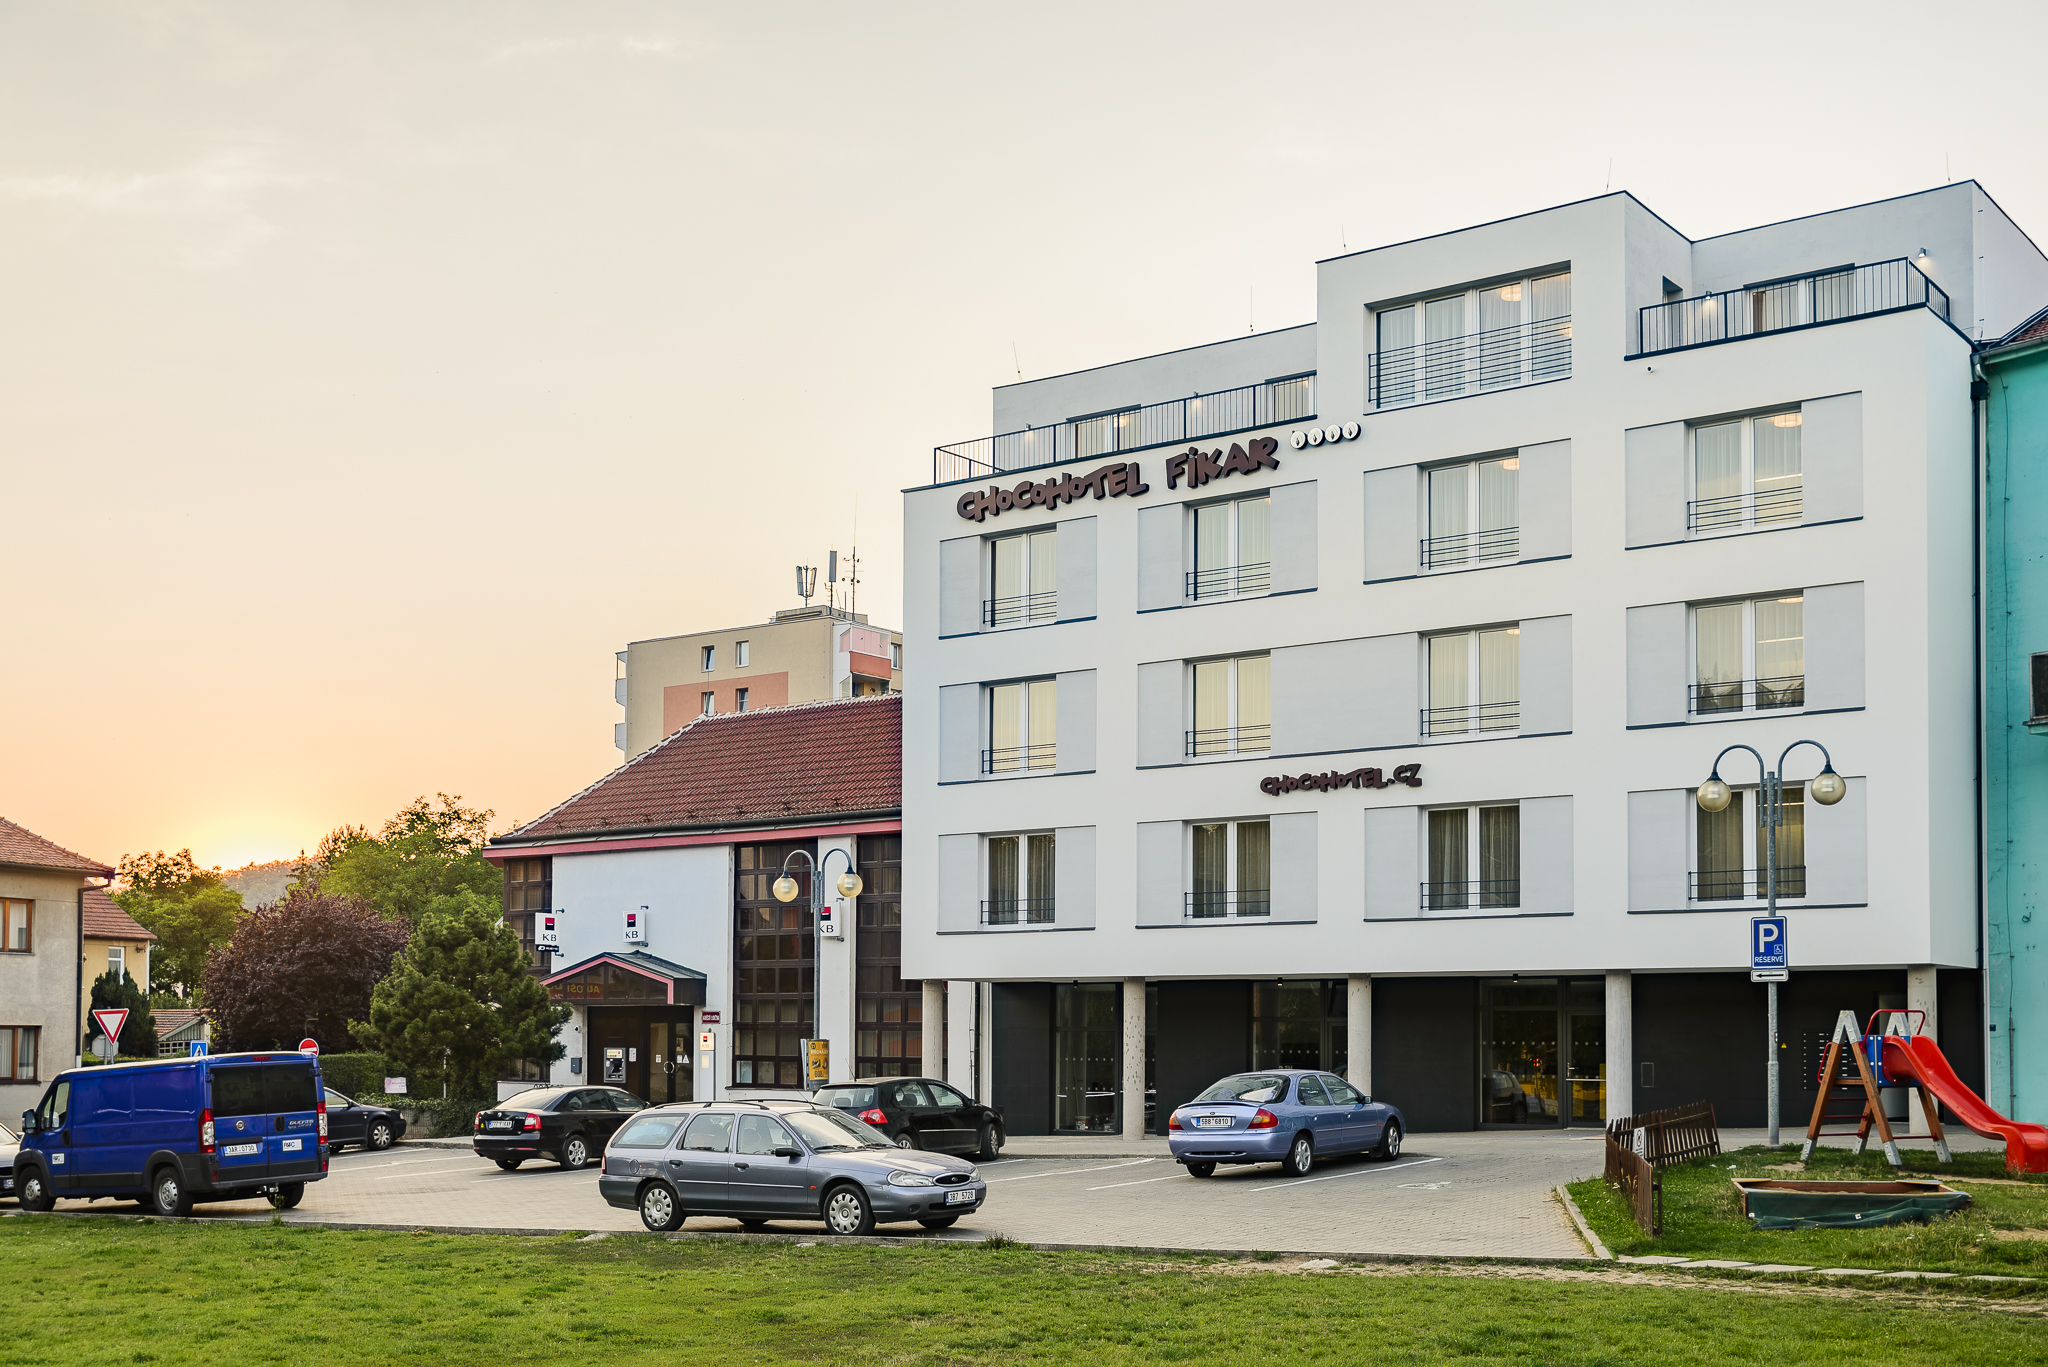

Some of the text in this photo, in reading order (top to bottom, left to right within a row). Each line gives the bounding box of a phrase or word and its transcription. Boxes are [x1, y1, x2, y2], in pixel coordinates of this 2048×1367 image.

[957, 461, 1149, 522] CHOCOHOTEL
[1260, 763, 1422, 796] CHOCOHOTEL.CZ
[625, 931, 638, 939] KB
[1759, 924, 1778, 952] P
